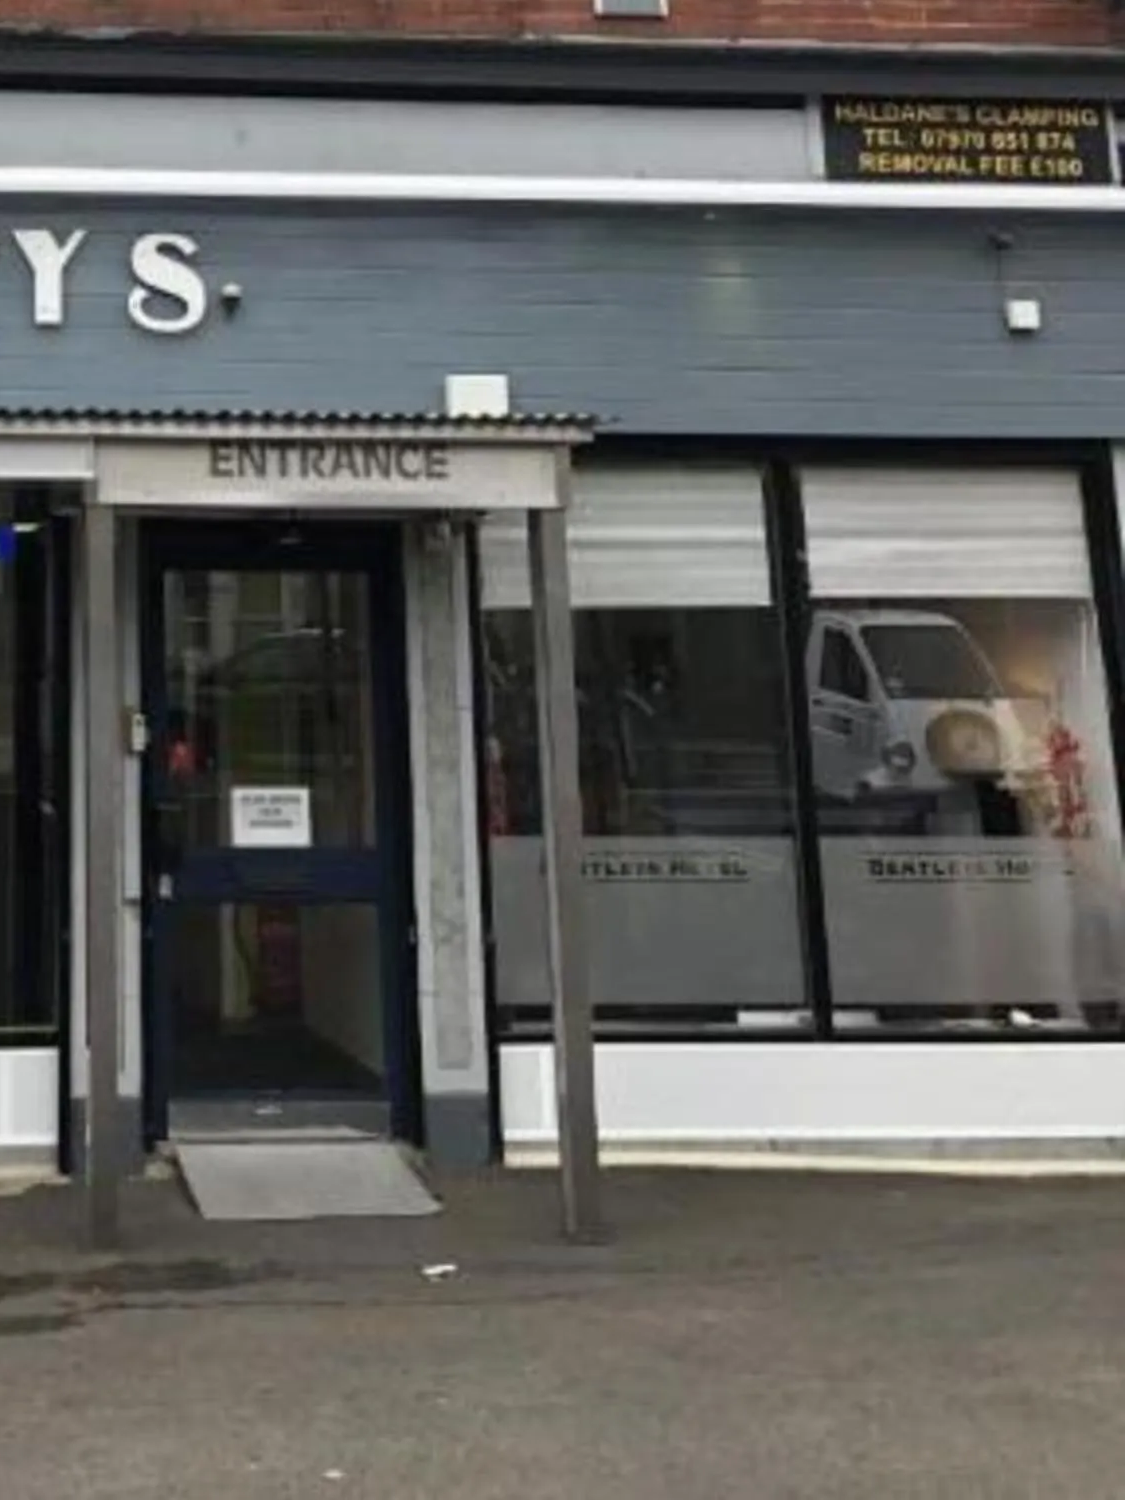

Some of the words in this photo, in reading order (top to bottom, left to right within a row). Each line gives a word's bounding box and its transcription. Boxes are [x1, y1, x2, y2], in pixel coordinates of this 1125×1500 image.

[975, 105, 1100, 127] CLAMPING
[858, 152, 973, 174] REMOVAL
[978, 155, 1024, 176] FEE
[208, 441, 451, 481] ENTRANCE
